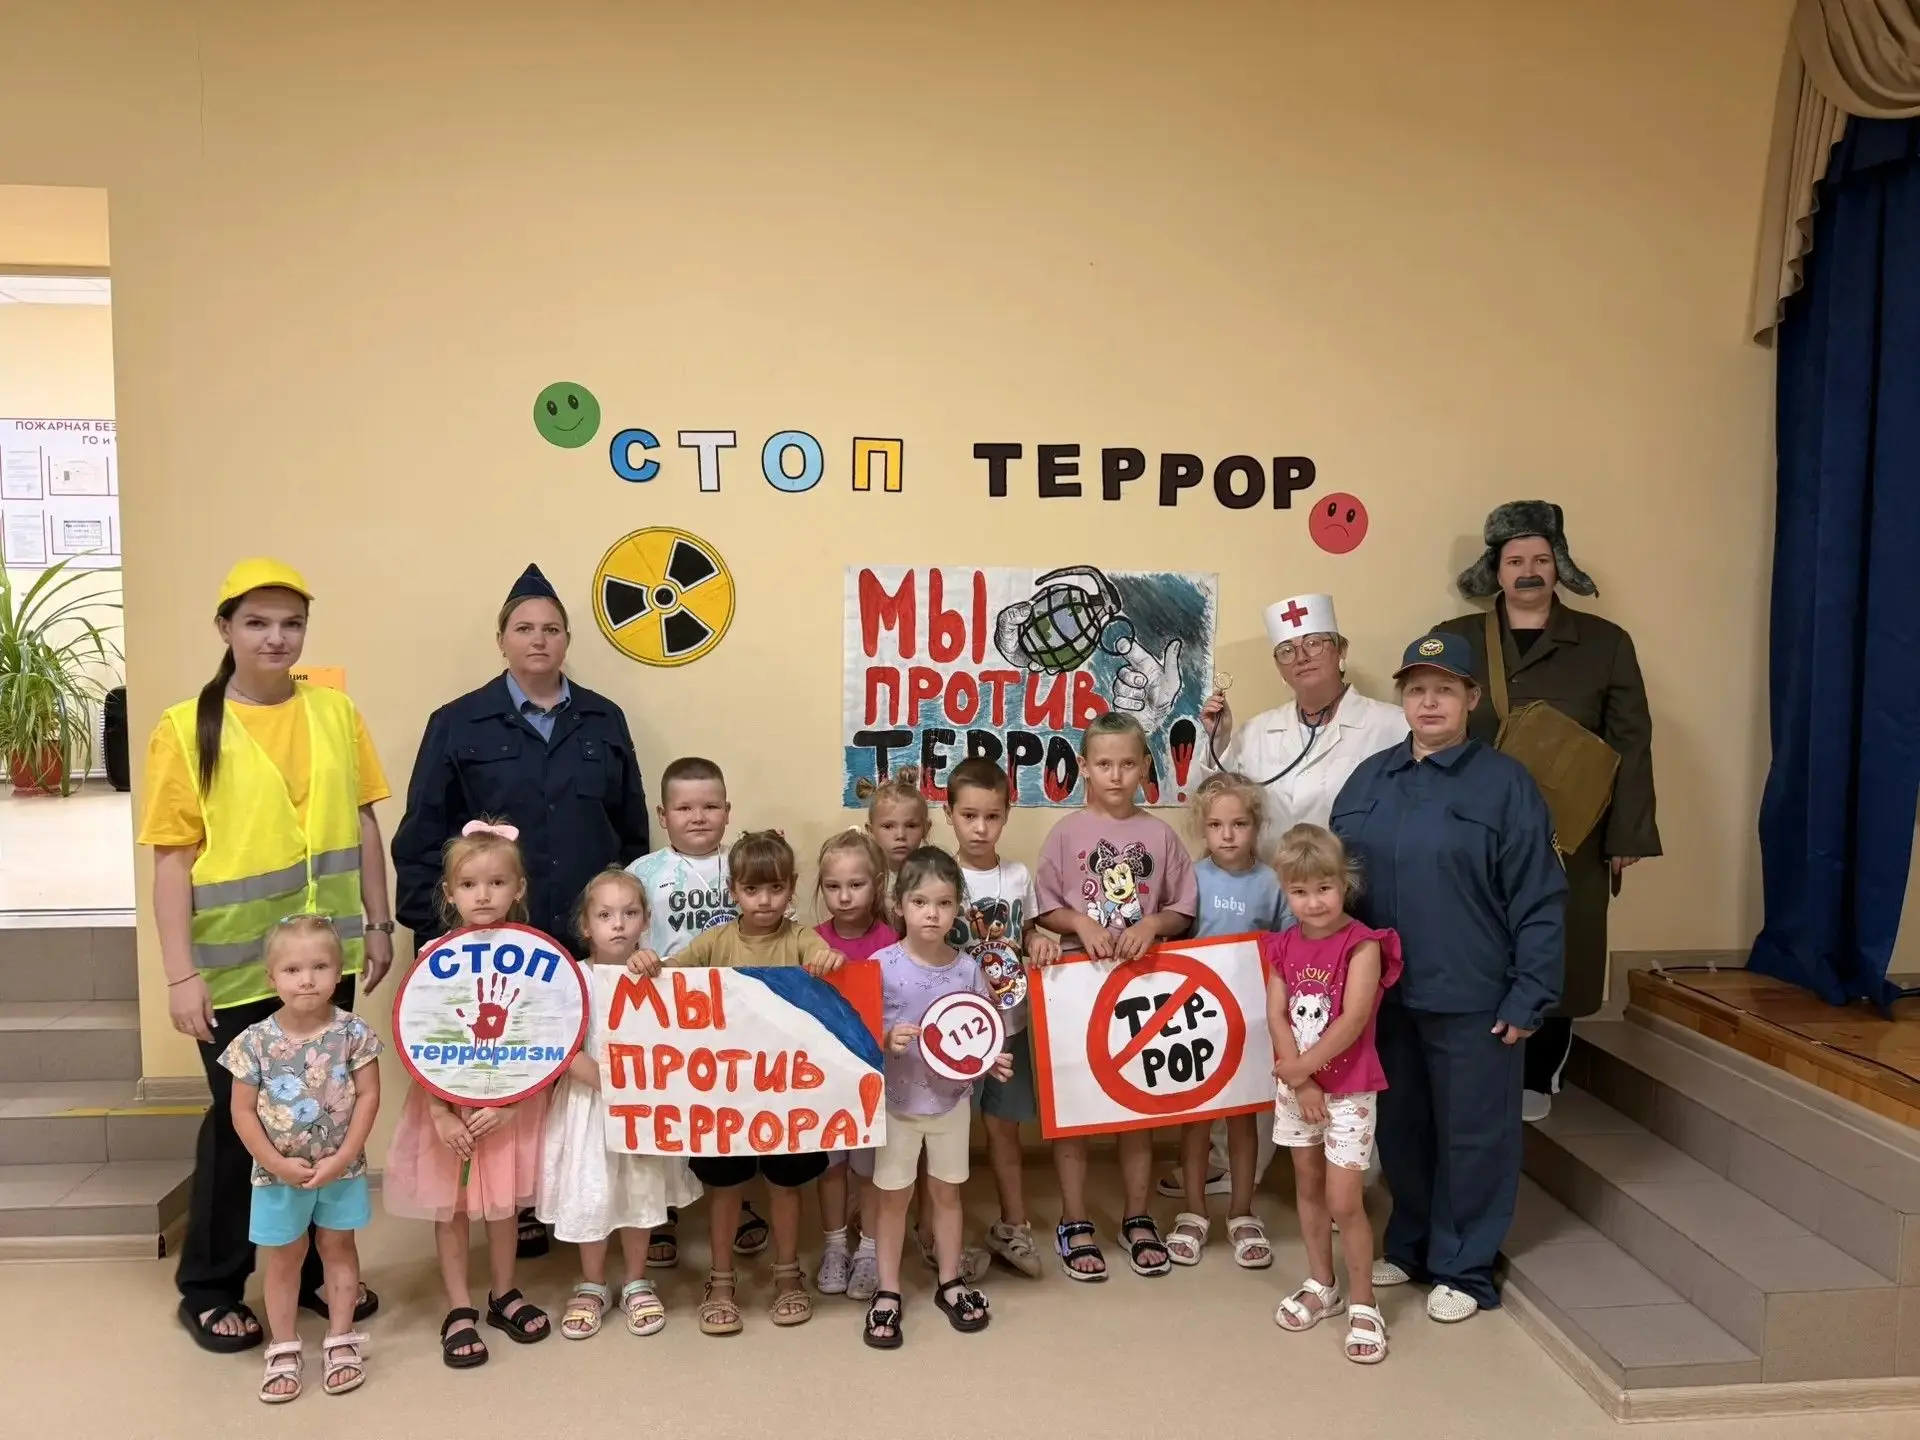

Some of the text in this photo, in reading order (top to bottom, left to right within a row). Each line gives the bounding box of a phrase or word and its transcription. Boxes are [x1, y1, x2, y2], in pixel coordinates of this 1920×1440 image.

[15, 421, 90, 431] ПОЖАРНАЯ
[82, 435, 98, 445] ГО
[609, 428, 1316, 510] СТОП ТЕРРОР
[858, 567, 988, 665] МЫ
[865, 666, 1111, 731] ПРОТИВ
[1213, 895, 1246, 916] baby
[428, 943, 561, 983] СТОП
[608, 968, 727, 1030] МЫ
[409, 1044, 565, 1067] терроризм
[948, 1016, 989, 1046] 112
[608, 1043, 826, 1092] ПРОТИВ
[1141, 1038, 1215, 1088] РОР
[608, 1072, 883, 1154] ТЕРРОРА!
